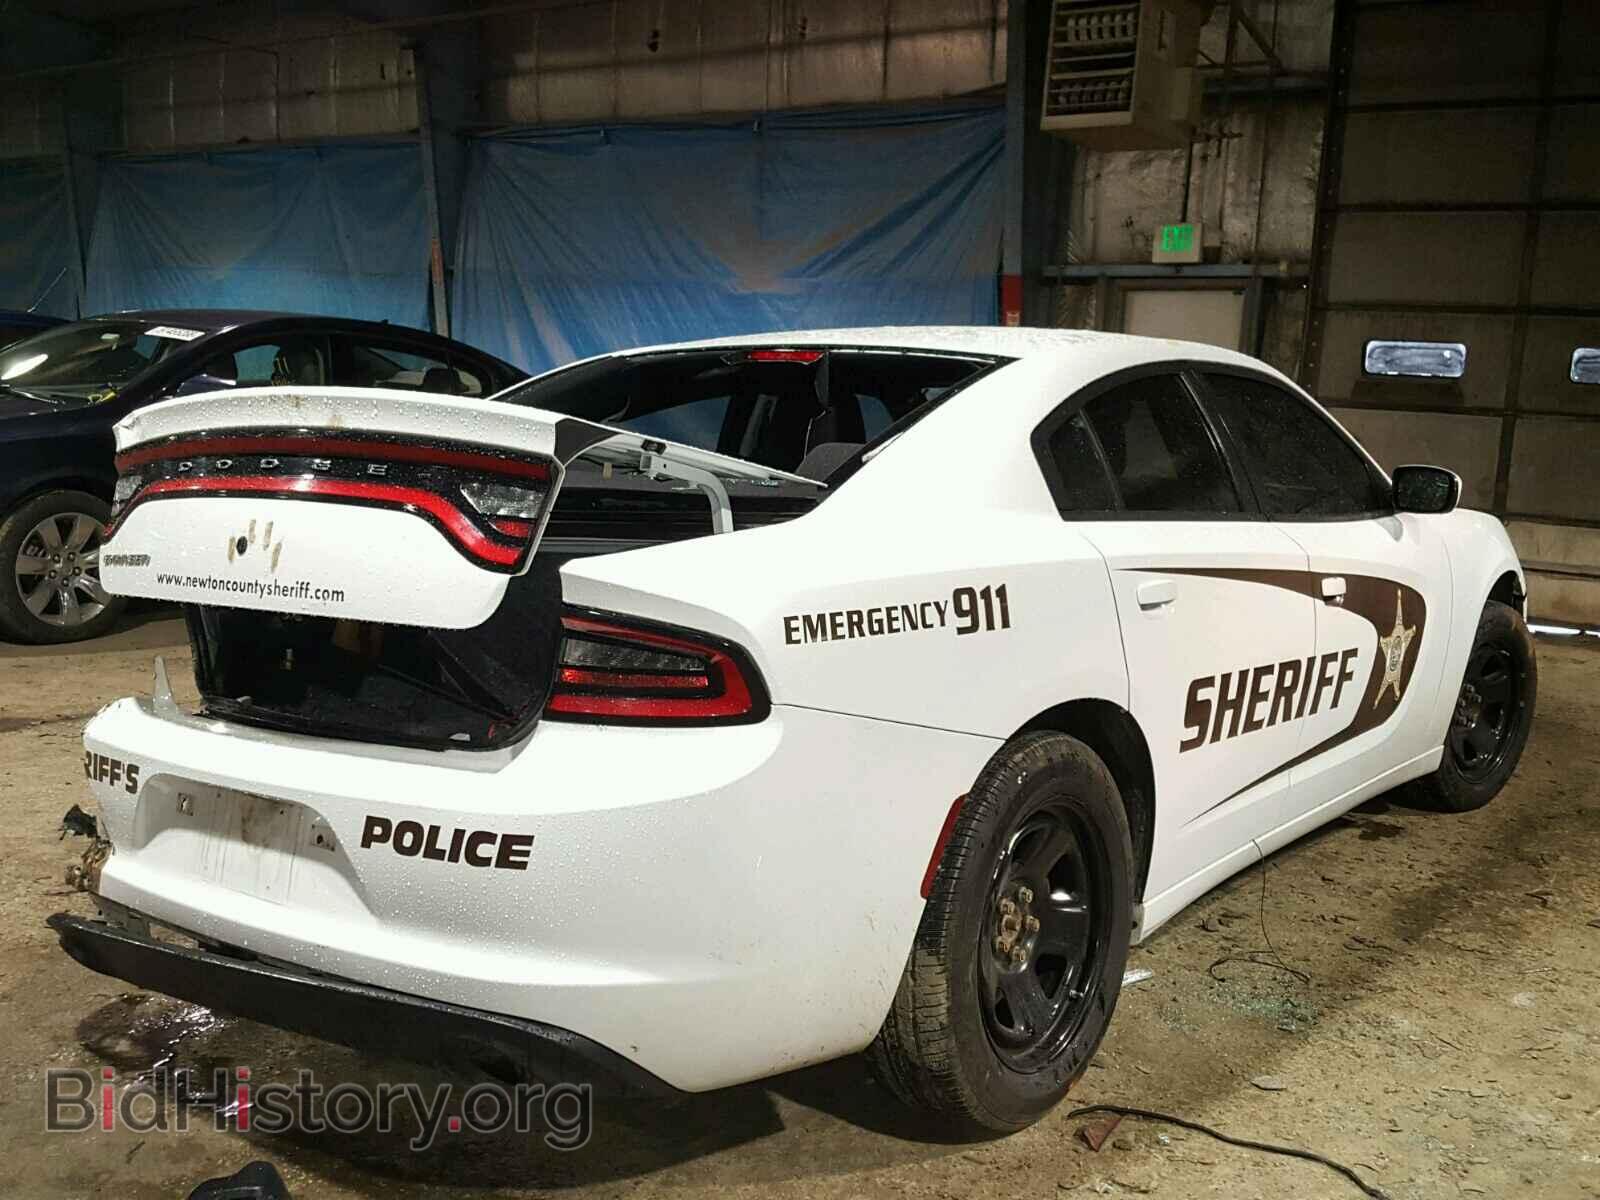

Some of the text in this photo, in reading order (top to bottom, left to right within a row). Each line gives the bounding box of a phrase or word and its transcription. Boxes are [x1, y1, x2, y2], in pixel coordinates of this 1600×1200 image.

[156, 572, 345, 604] www.newtoncountysheriff.com
[783, 583, 1011, 645] EMERGENCY 911
[1179, 647, 1358, 754] SHERIFF
[360, 815, 535, 870] POLICE
